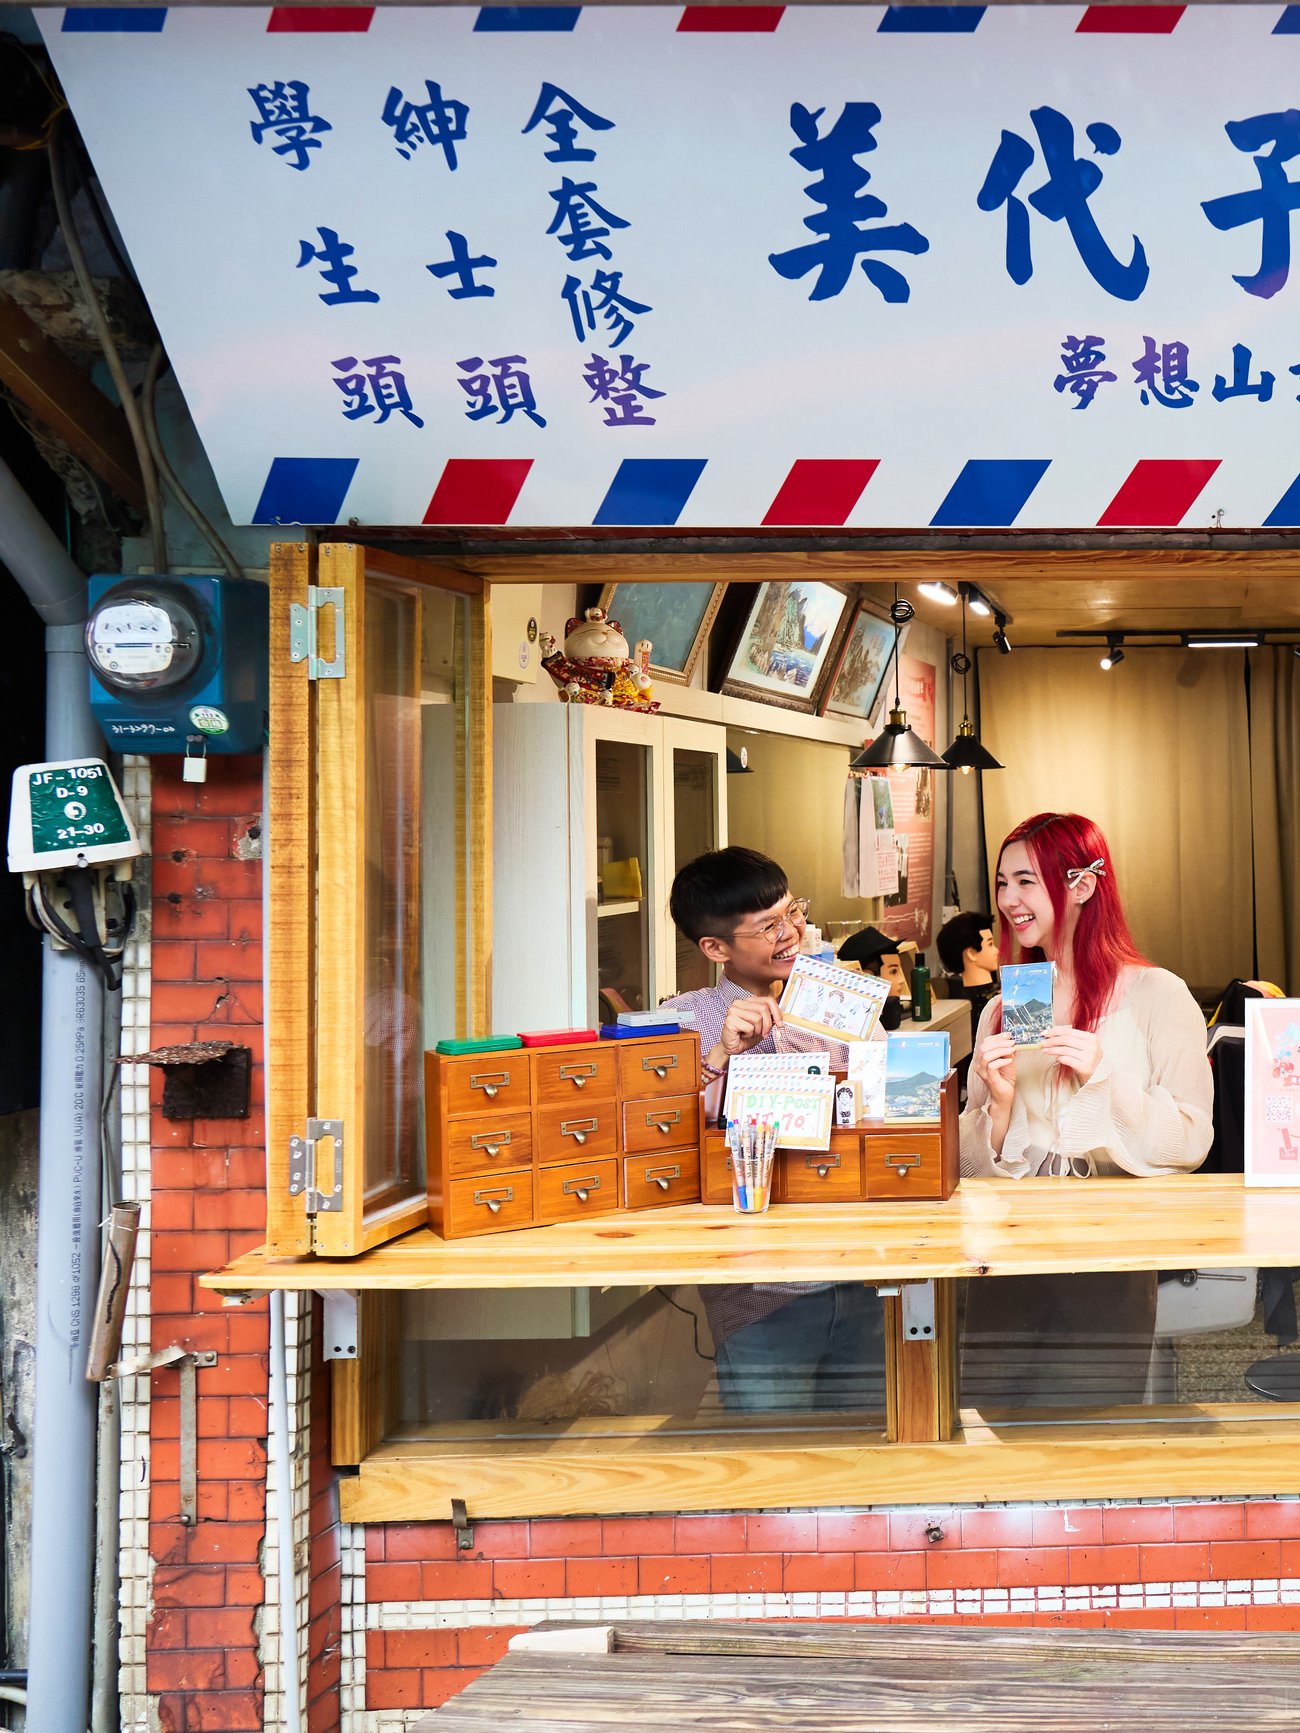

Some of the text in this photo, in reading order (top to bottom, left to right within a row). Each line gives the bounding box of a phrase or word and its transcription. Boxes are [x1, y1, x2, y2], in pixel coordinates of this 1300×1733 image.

[246, 79, 425, 429] 學生頭
[380, 78, 548, 429] 紳士頭
[520, 80, 668, 428] 全套修整
[56, 785, 89, 798] D-9
[57, 823, 105, 840] 21-30
[69, 1309, 81, 1327] CNS
